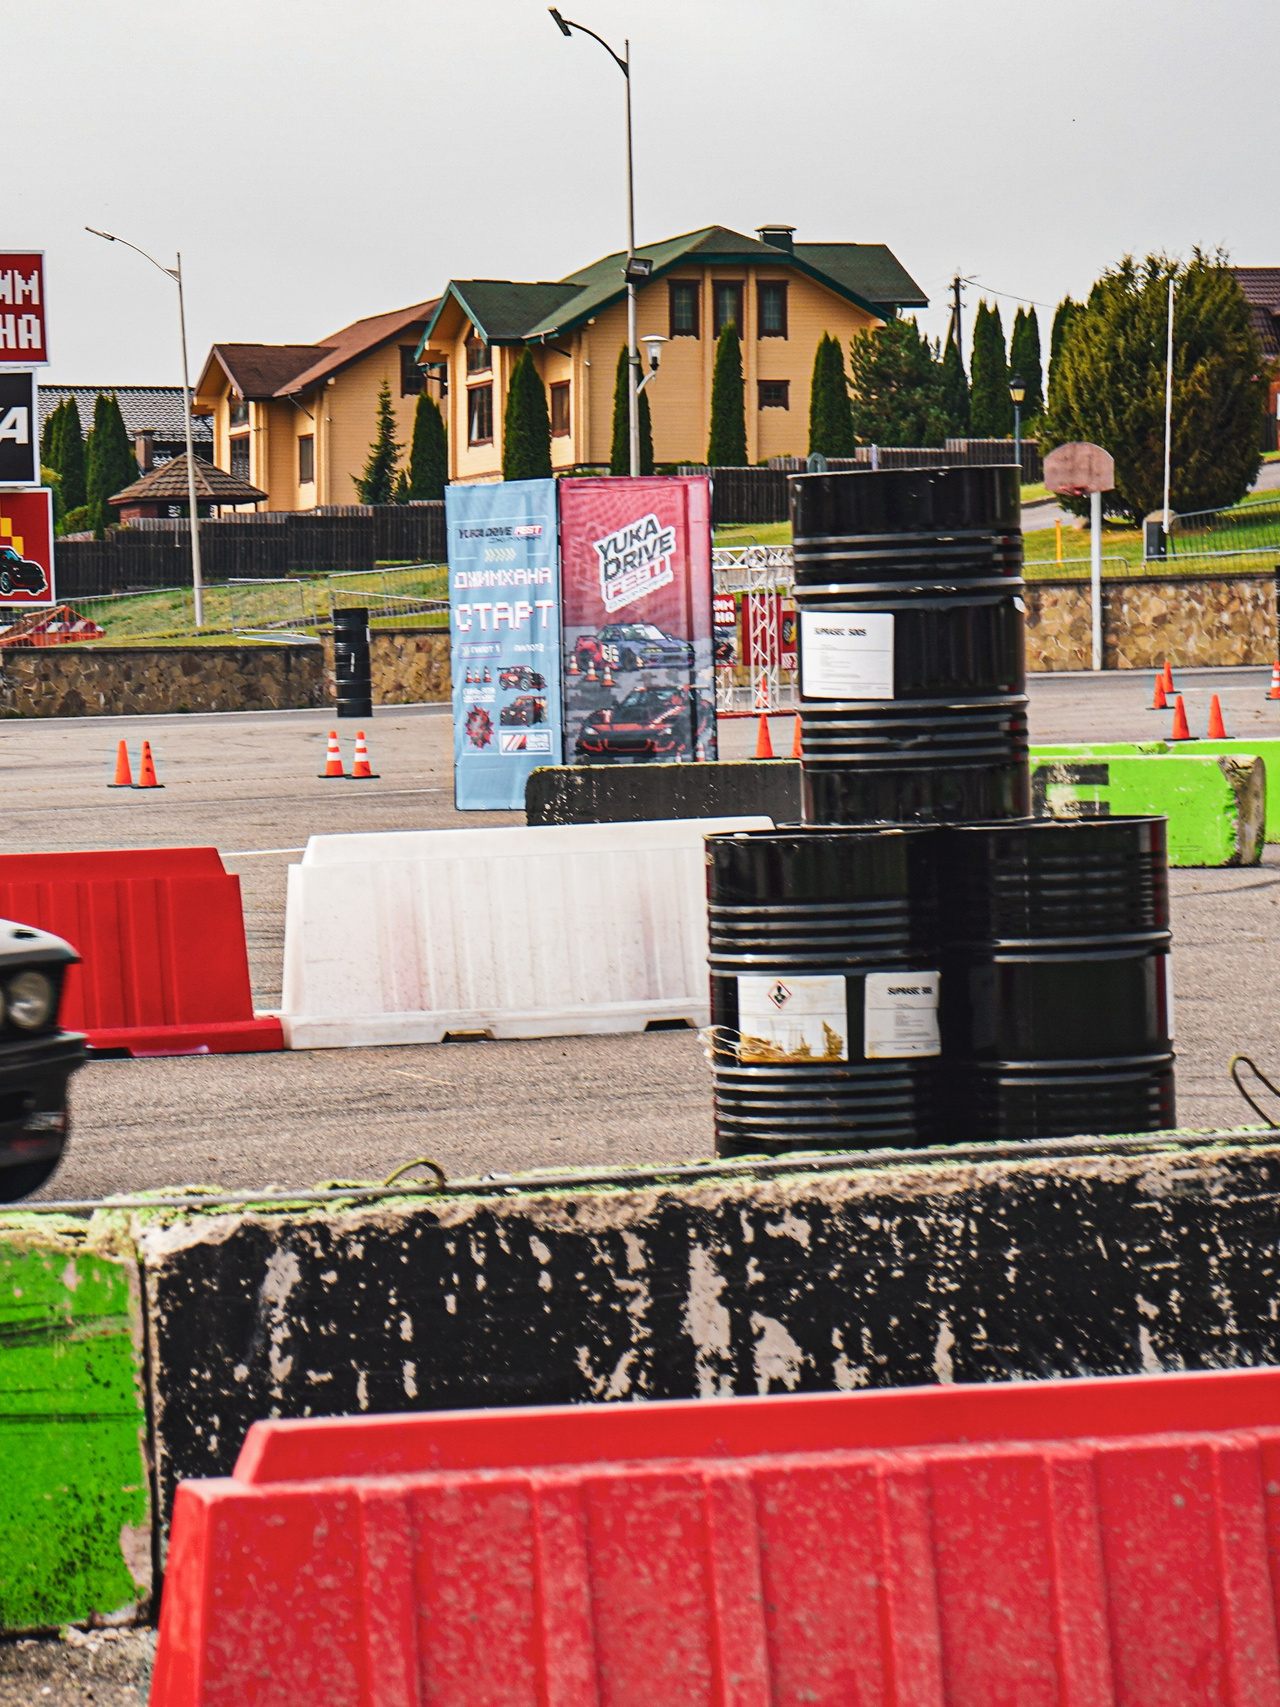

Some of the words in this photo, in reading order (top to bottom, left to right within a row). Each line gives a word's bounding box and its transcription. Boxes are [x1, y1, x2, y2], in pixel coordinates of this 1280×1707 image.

[598, 518, 658, 561] YUKA
[604, 531, 672, 582] DRIVE
[454, 566, 552, 589] ДЖИМХАНА
[454, 599, 555, 632] СТАРТ
